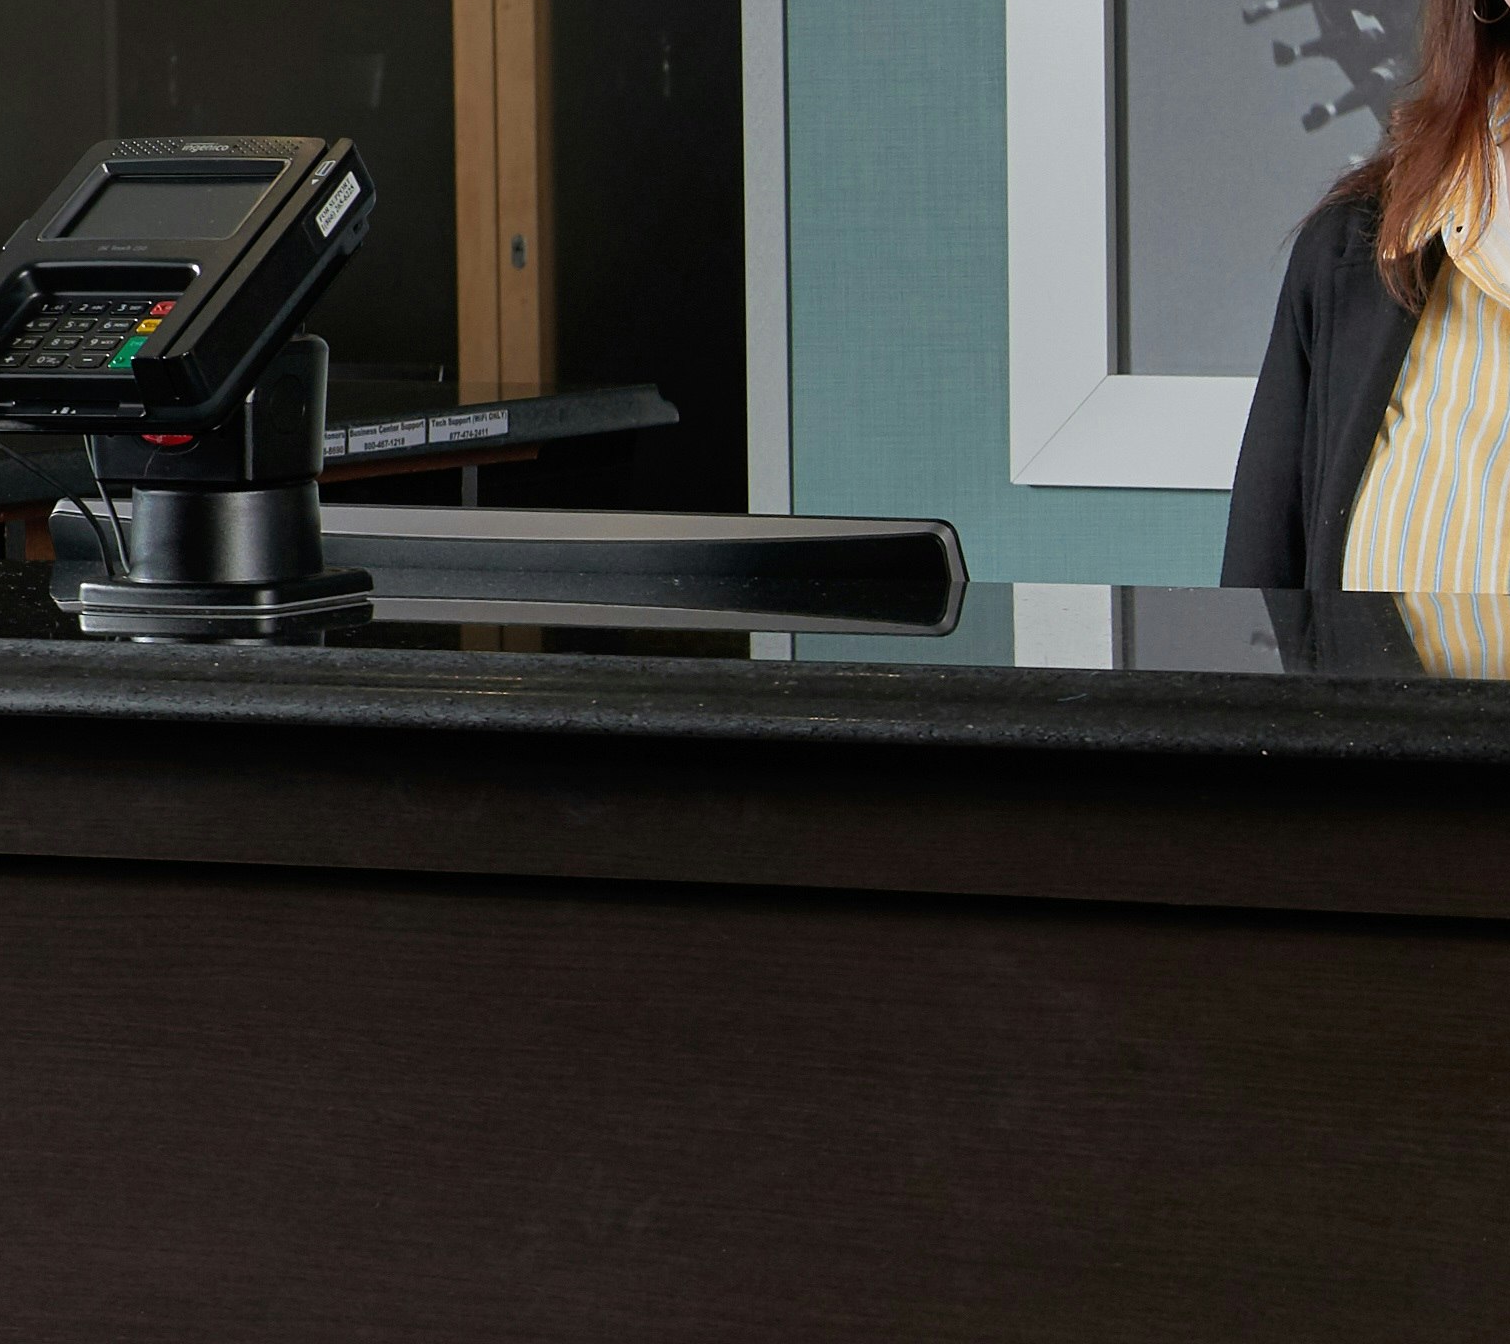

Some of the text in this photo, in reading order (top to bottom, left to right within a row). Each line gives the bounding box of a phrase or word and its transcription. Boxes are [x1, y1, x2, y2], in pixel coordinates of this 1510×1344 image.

[181, 143, 229, 153] ingenico
[431, 419, 446, 427] Tech
[448, 416, 471, 427] Support
[349, 421, 424, 438] Business Center Support
